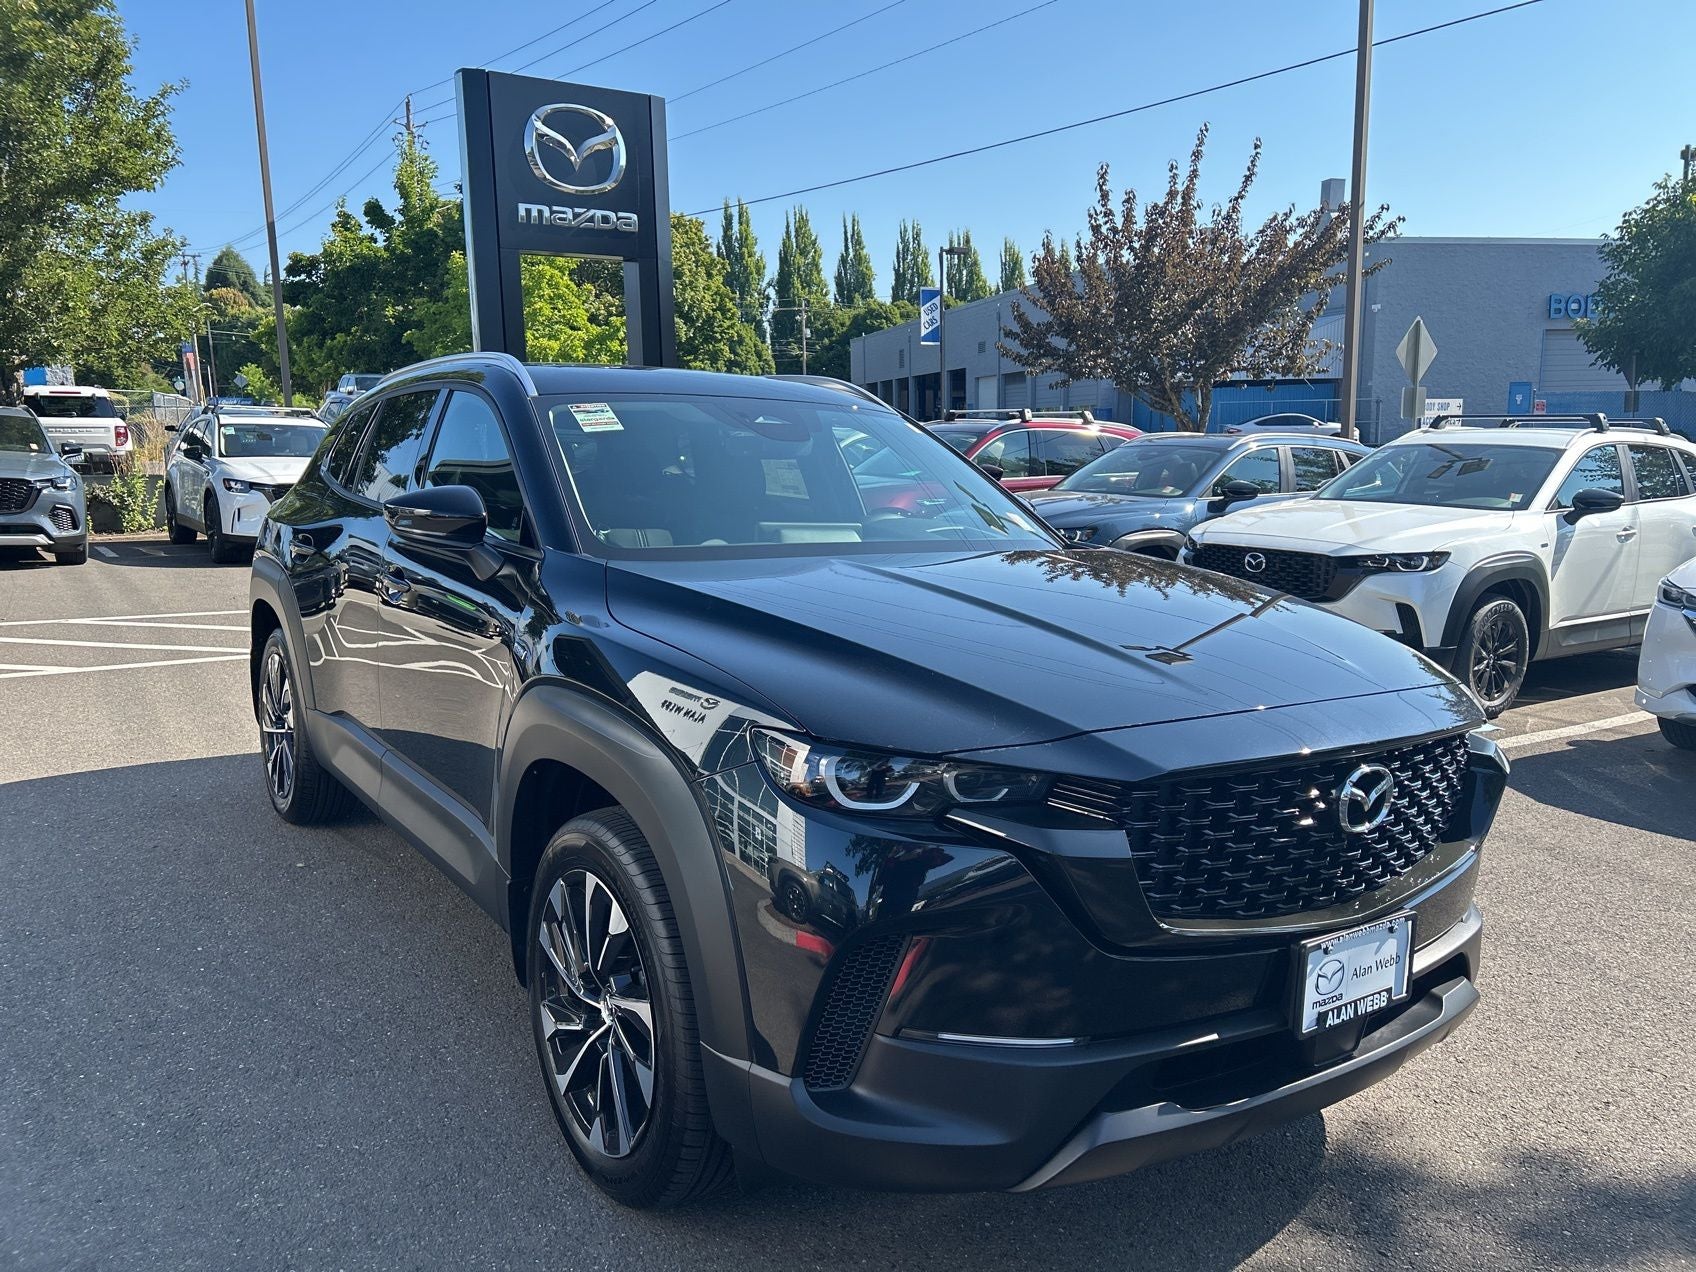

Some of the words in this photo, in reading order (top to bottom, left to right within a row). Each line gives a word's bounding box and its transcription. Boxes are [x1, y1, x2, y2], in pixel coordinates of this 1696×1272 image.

[518, 202, 639, 233] mazda
[923, 302, 939, 316] USED
[923, 316, 938, 330] CARS
[1425, 402, 1435, 411] ODY
[1437, 402, 1451, 411] SHOP
[1351, 965, 1373, 981] Alan
[1375, 953, 1401, 972] Webb
[1312, 993, 1343, 1010] mazda
[1326, 1005, 1355, 1028] ALAN
[1356, 991, 1389, 1016] WEBB
